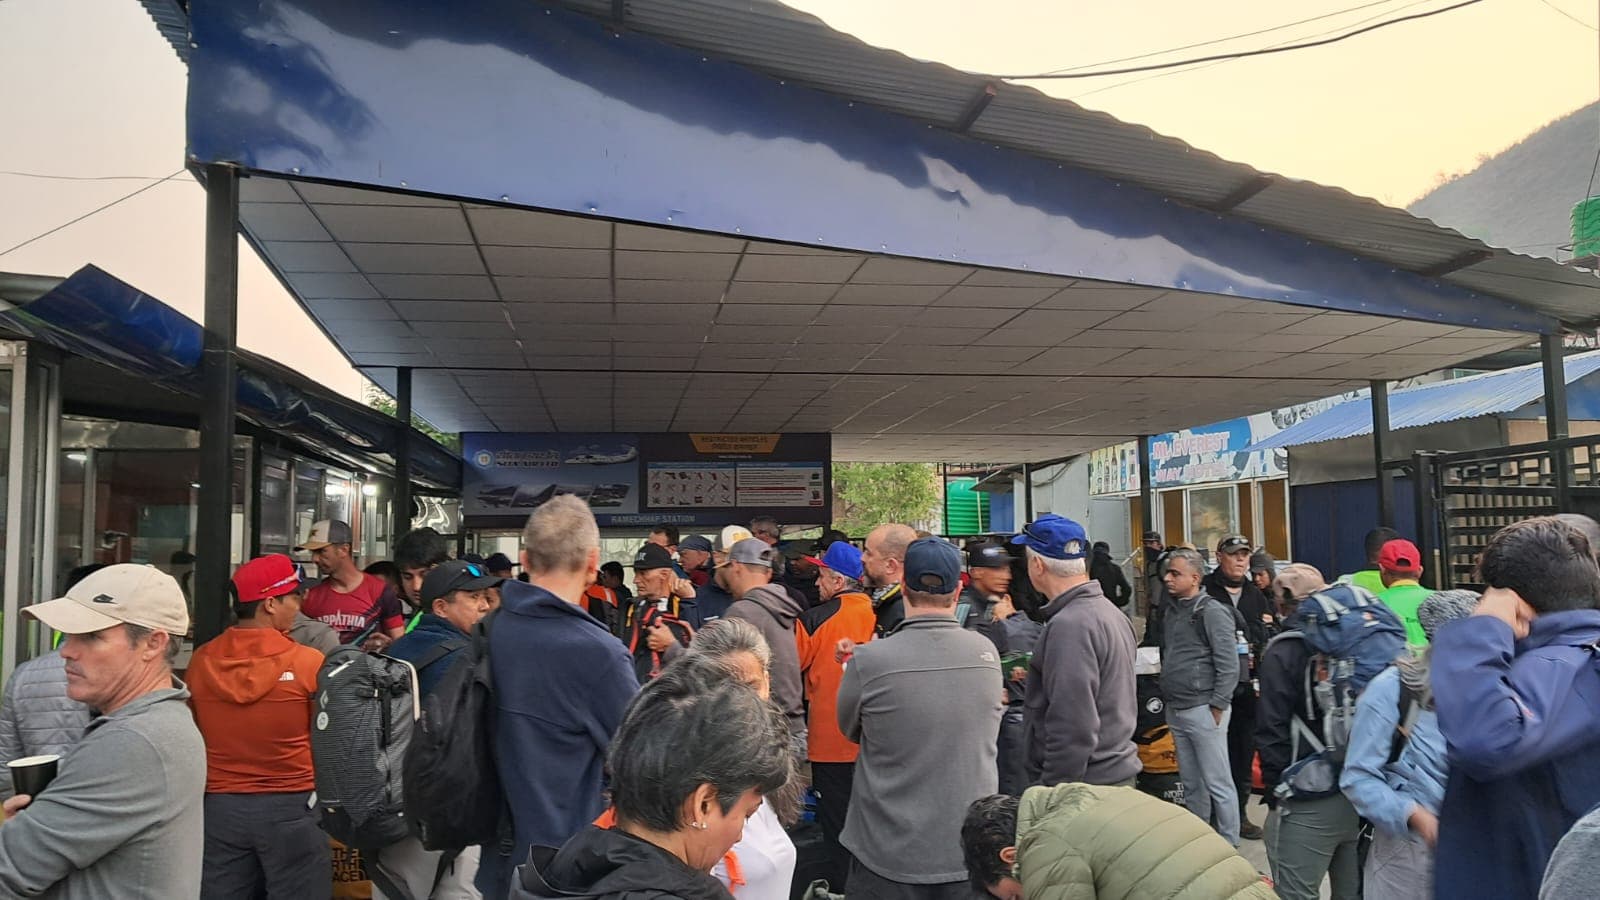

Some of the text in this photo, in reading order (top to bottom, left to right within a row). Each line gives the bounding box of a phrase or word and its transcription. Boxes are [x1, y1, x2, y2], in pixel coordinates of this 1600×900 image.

[1173, 432, 1229, 454] EVEREST
[1155, 467, 1181, 482] WAY
[662, 514, 696, 522] STATION
